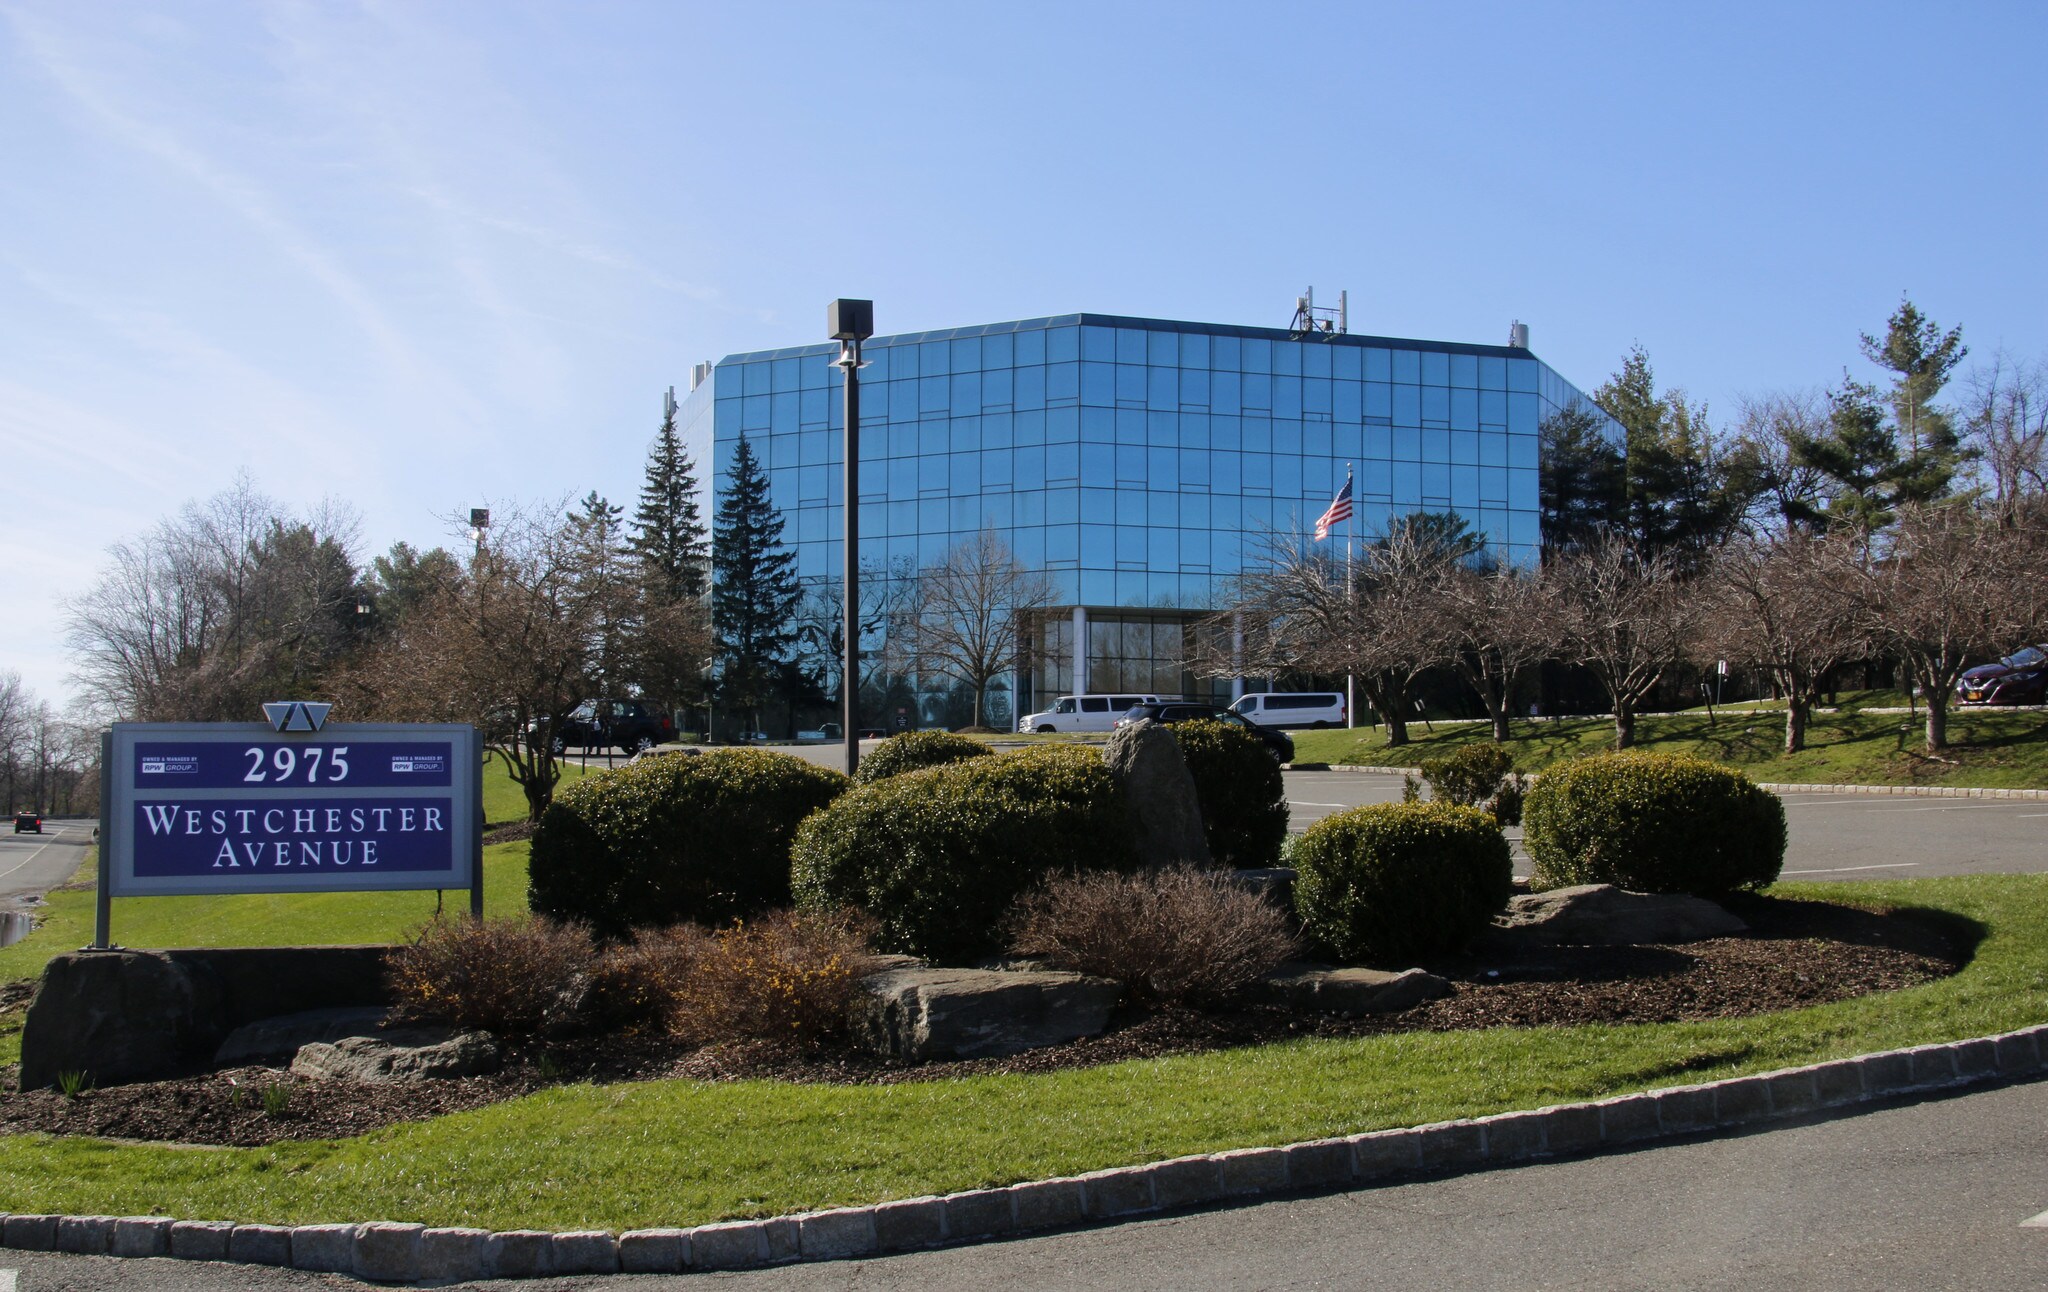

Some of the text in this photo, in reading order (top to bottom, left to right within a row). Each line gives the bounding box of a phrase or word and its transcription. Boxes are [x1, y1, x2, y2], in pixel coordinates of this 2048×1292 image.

[244, 747, 349, 782] 2975
[142, 805, 444, 835] WESTCHESTER
[213, 837, 378, 867] AVENUE
